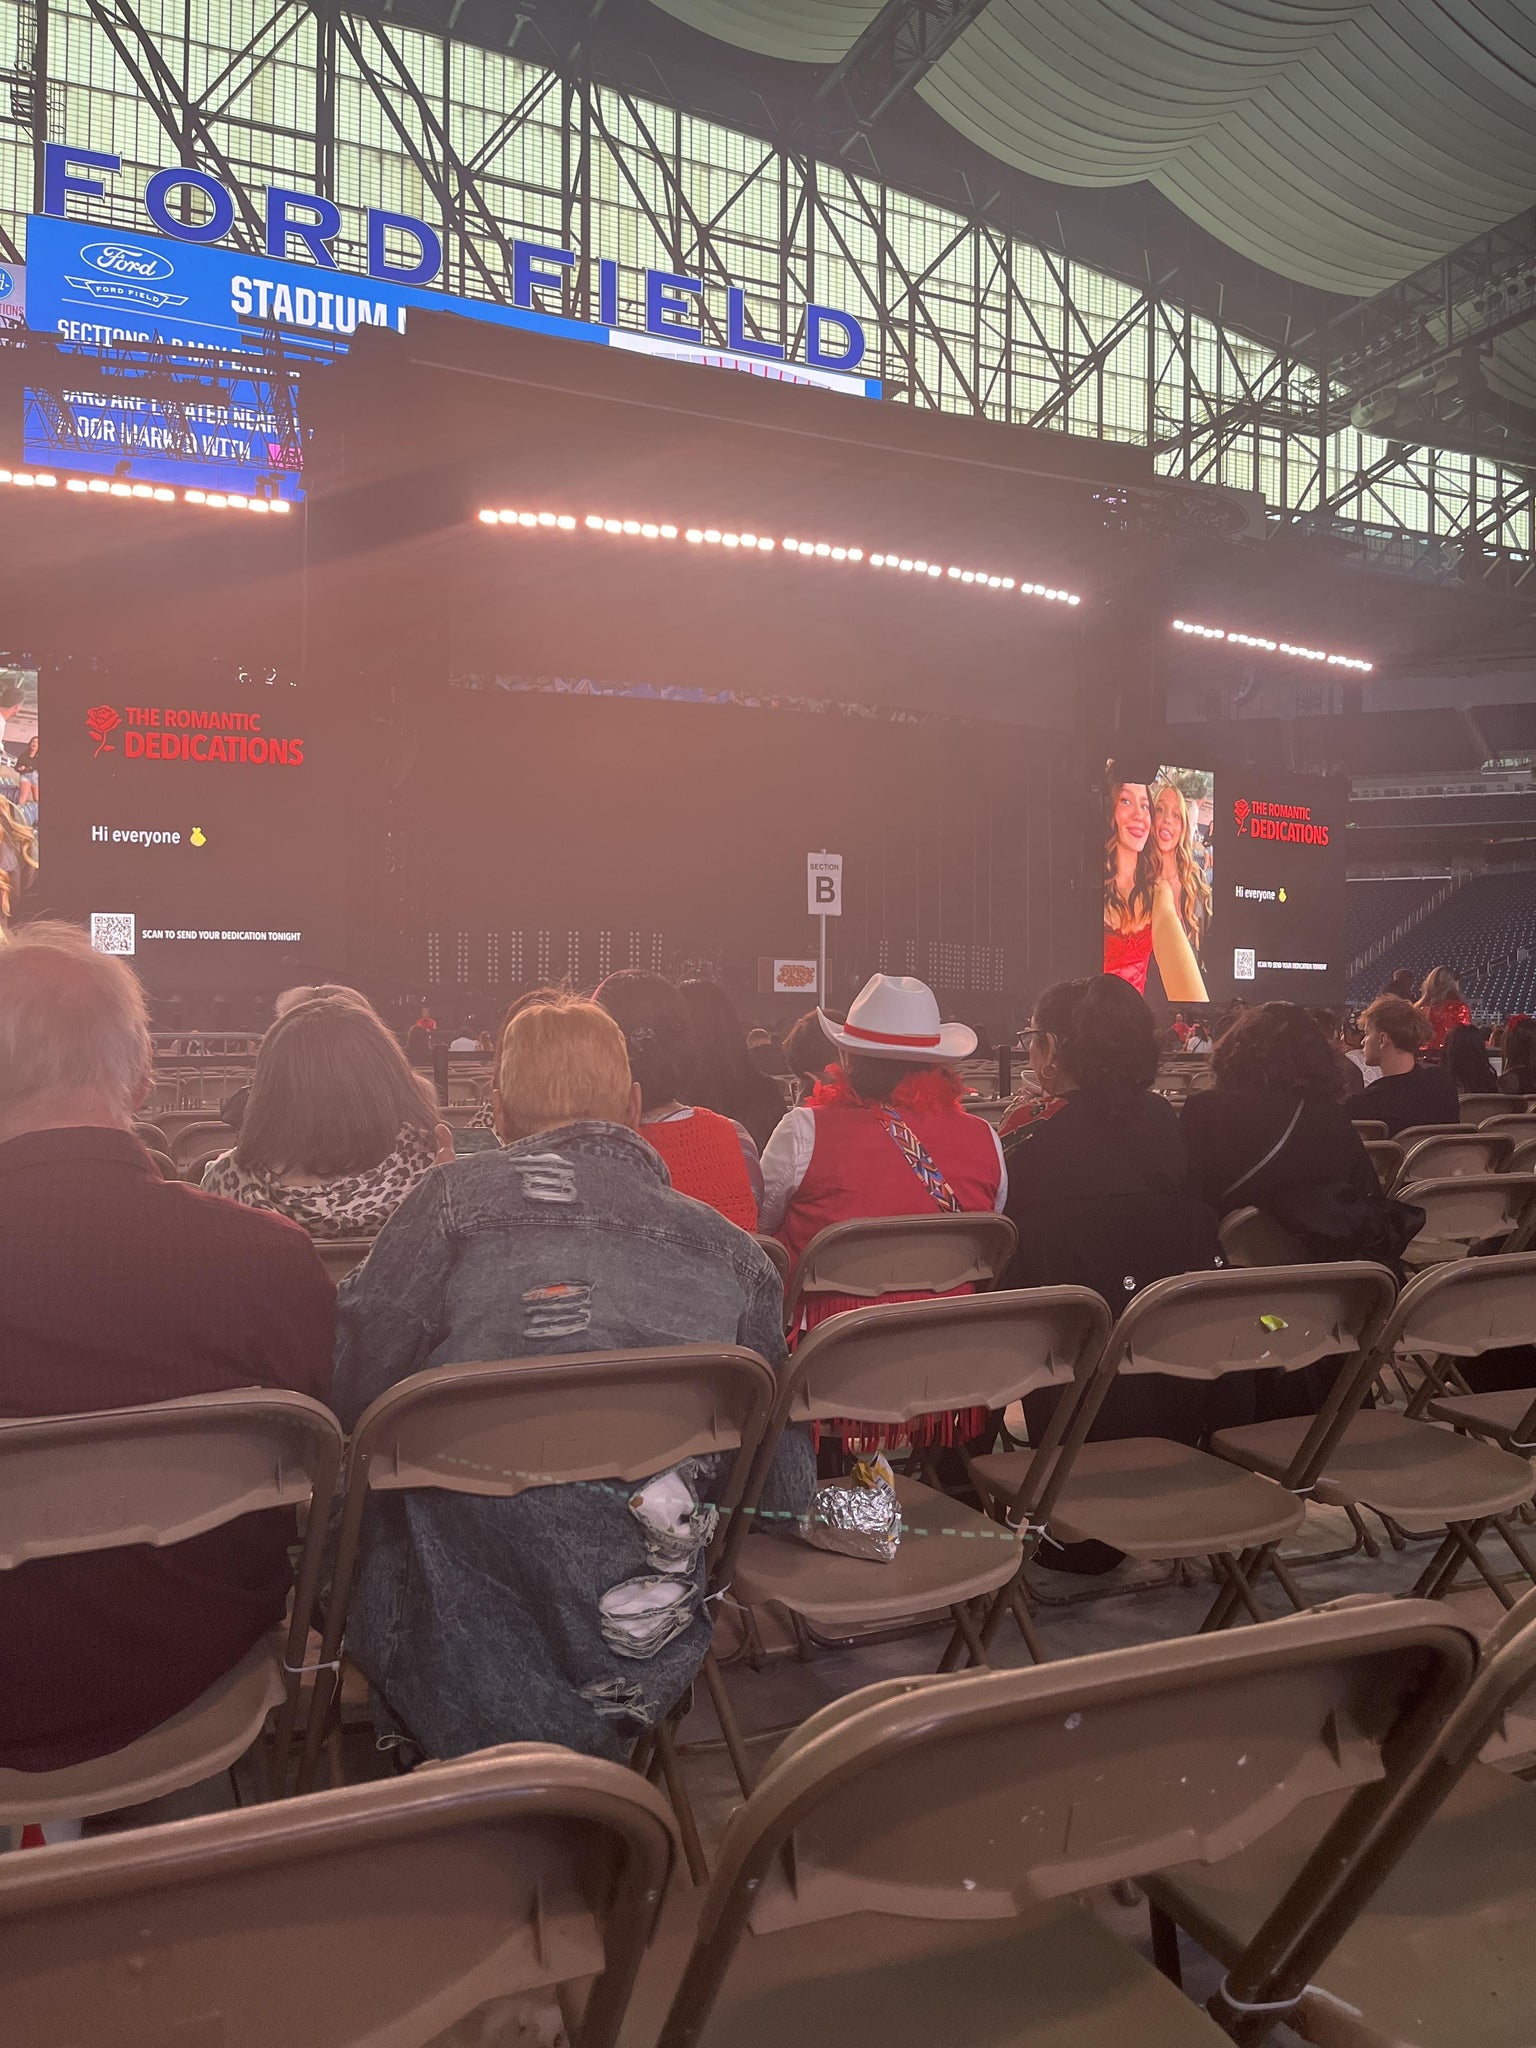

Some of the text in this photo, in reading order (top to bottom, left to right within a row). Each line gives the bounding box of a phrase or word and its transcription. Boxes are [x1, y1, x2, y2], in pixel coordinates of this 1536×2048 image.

[42, 141, 866, 371] FORD FIELD
[96, 246, 158, 276] Ford
[96, 286, 160, 303] FORD FIELD
[231, 275, 388, 334] STADIUM
[125, 707, 261, 732] THE ROMANTIC
[124, 731, 304, 766] DEDICATIONS
[1251, 801, 1311, 821] THE ROMANTIC
[91, 825, 181, 848] Hi everyone
[1251, 818, 1329, 846] DEDICATIONS
[810, 863, 840, 871] SECTION
[815, 876, 836, 903] B
[1235, 885, 1276, 903] Hi everyone
[142, 929, 301, 942] SCAN TO SEND YOUR DEDICATION TONIGHT
